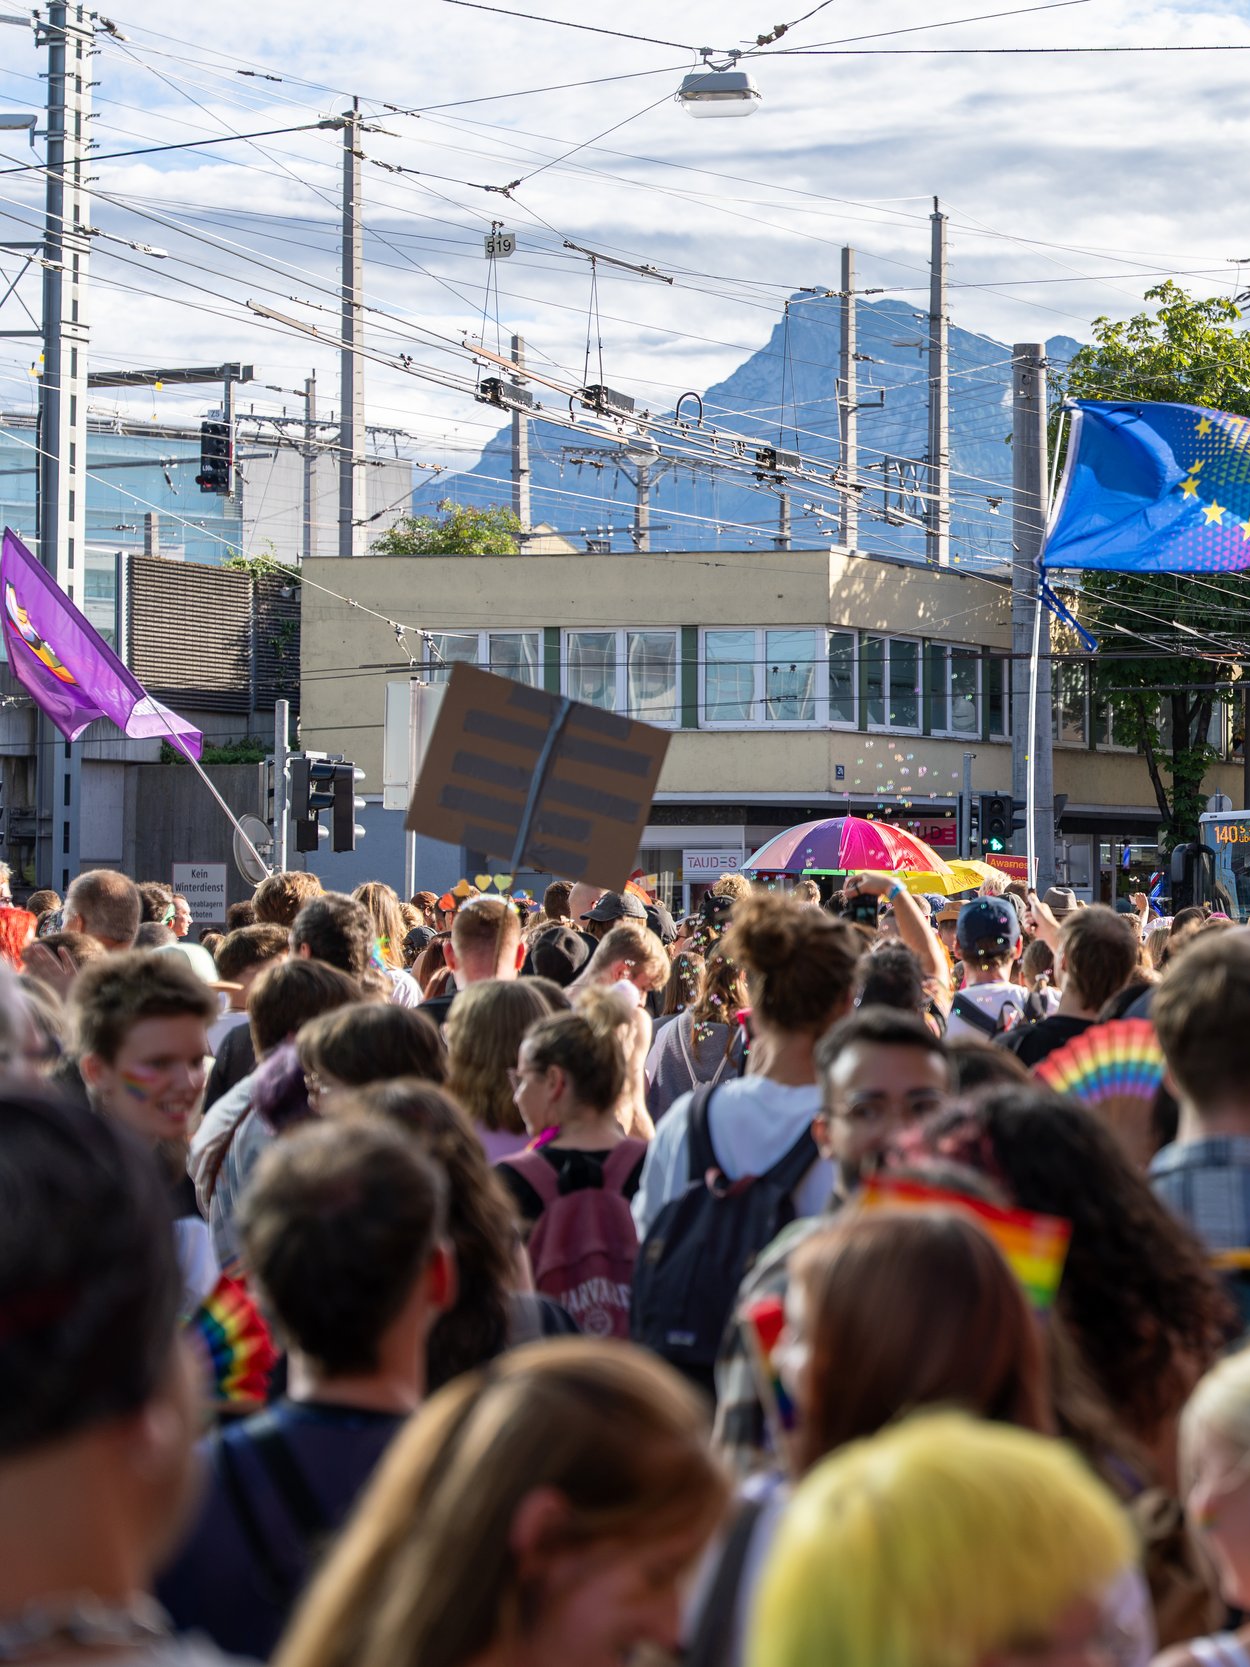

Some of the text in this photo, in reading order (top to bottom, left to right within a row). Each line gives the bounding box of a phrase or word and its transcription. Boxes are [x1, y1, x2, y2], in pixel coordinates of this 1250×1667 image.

[486, 239, 511, 253] 519
[1214, 825, 1238, 844] 140
[687, 856, 737, 868] TAUDES
[191, 869, 208, 878] Kein
[174, 882, 224, 892] Winterdienst
[188, 901, 223, 909] eeablagern
